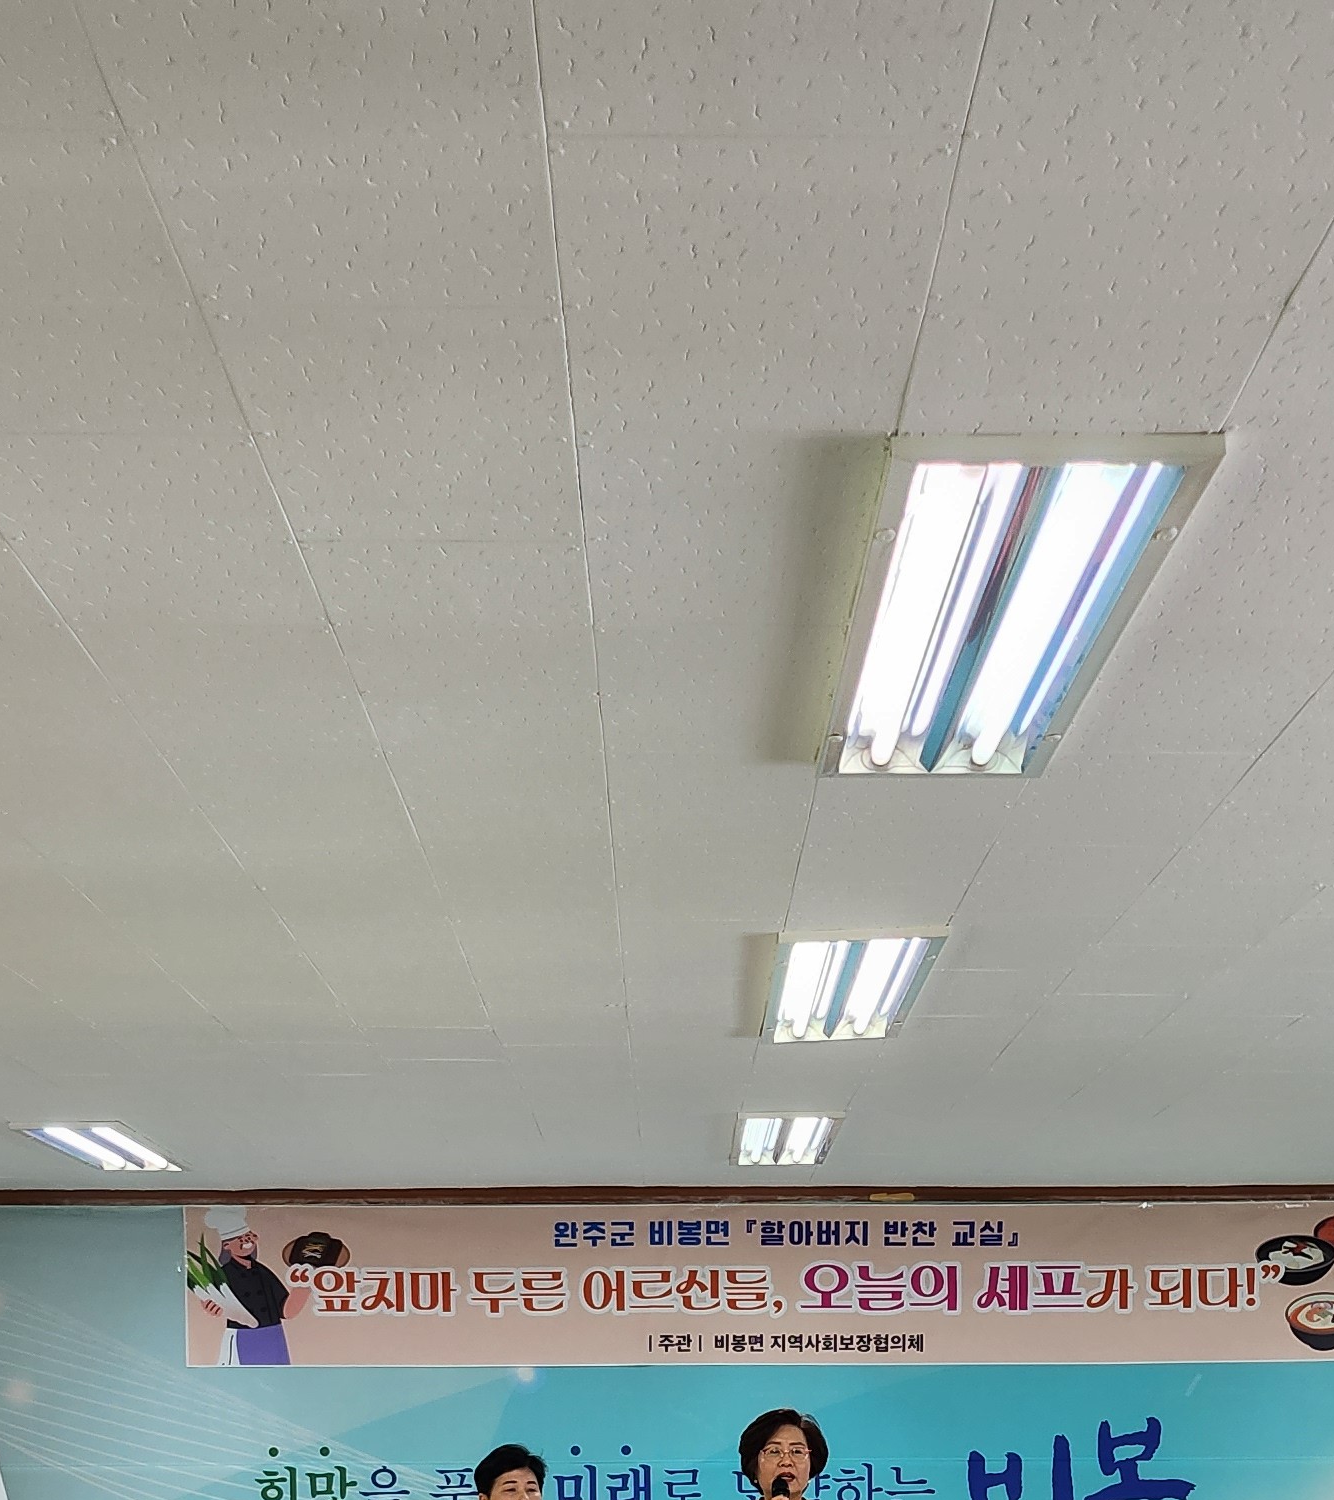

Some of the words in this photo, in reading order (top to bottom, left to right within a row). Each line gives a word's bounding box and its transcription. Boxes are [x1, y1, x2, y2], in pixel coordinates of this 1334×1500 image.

[553, 1220, 635, 1247] 완주군
[649, 1220, 730, 1247] 비봉면
[883, 1220, 937, 1247] 반찬
[472, 1268, 564, 1312] 두른
[583, 1268, 783, 1315] 어르신들,
[800, 1264, 959, 1311] 오늘의
[714, 1334, 764, 1353] 비봉면
[770, 1333, 925, 1353] 지역사회보장협의체
